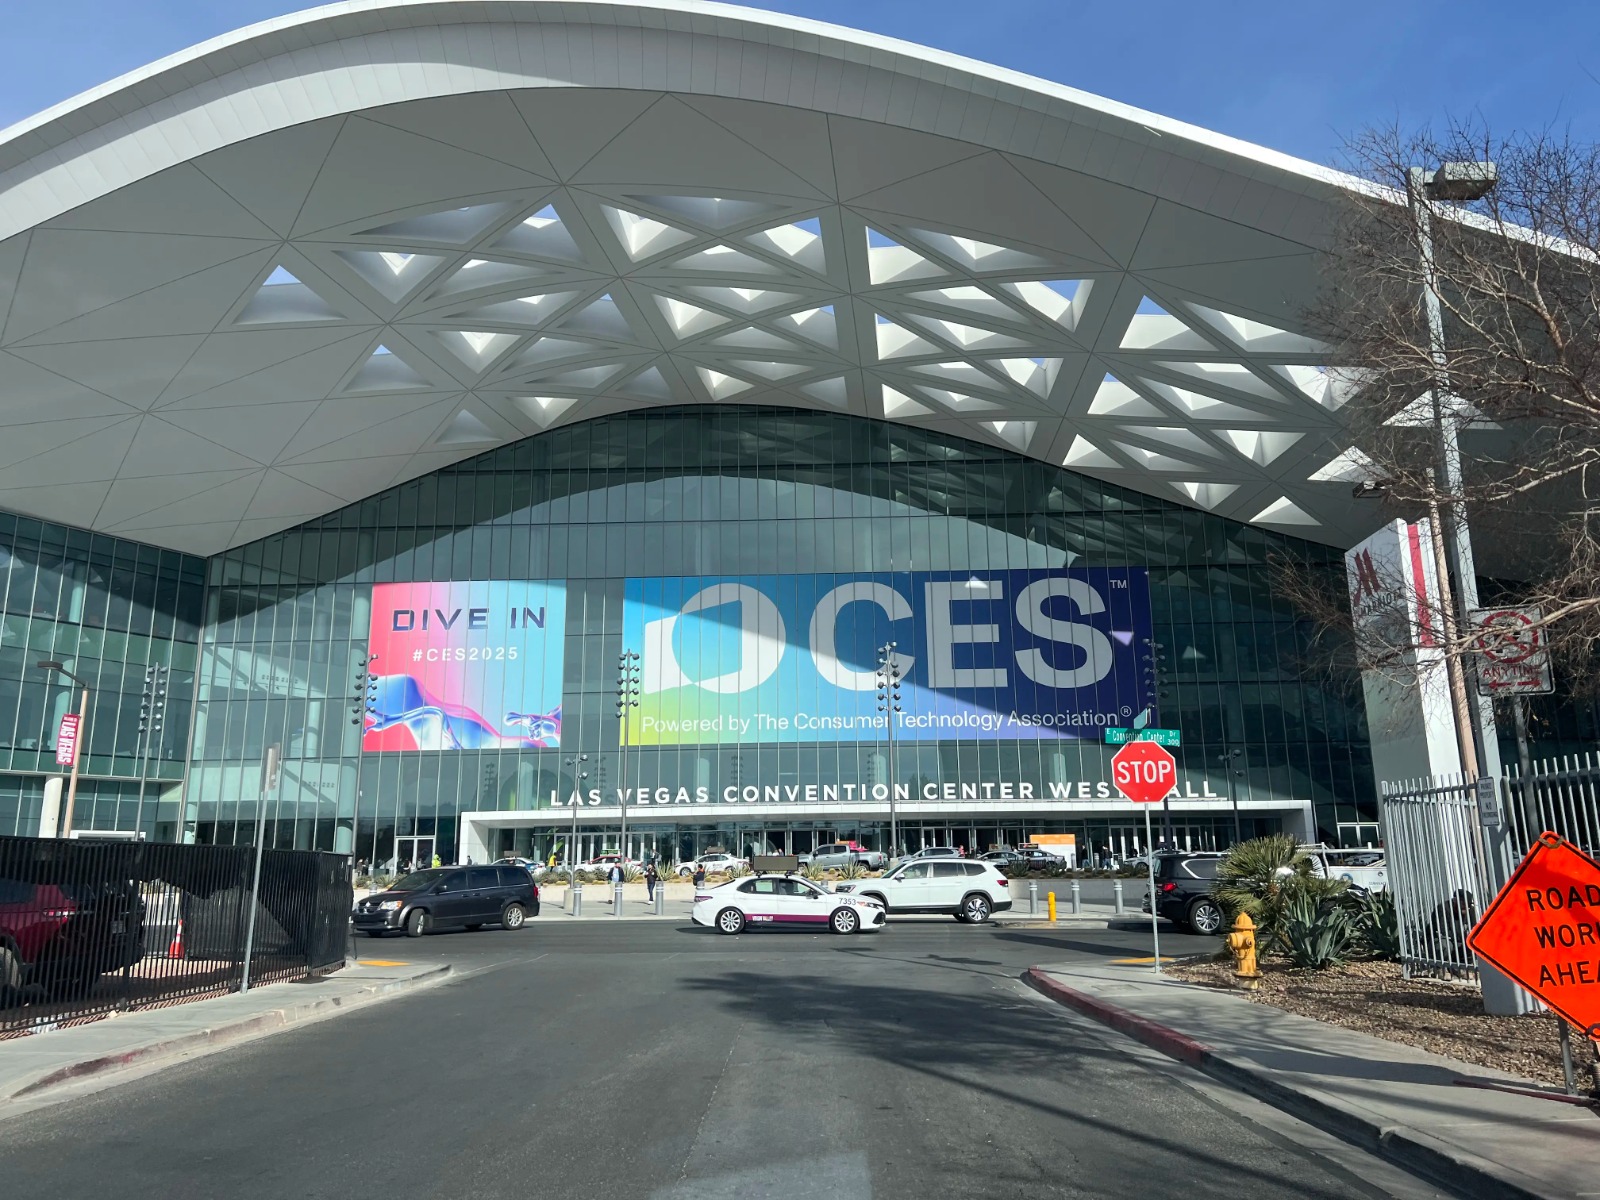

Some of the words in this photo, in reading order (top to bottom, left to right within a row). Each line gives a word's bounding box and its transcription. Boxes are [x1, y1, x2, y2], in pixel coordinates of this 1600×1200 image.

[392, 607, 490, 632] DIVE
[510, 606, 545, 629] IN
[412, 646, 518, 662] #CES2025
[642, 714, 723, 733] Powered
[729, 713, 751, 735] by
[754, 713, 789, 730] The
[794, 712, 890, 730] Consumer
[896, 710, 1003, 731] Technology
[1112, 729, 1143, 742] Convention
[1147, 731, 1165, 743] Center
[1117, 760, 1171, 784] STOP
[550, 789, 601, 806] LAS
[617, 786, 709, 804] VEGAS
[723, 782, 909, 802] CONVENTION
[923, 781, 1033, 800] CENTER
[1049, 781, 1125, 799] WES
[1165, 780, 1217, 798] ALL
[838, 897, 857, 906] 7353
[1526, 884, 1600, 911] ROAD
[1533, 922, 1600, 949] WOR
[1539, 960, 1600, 987] AHE
